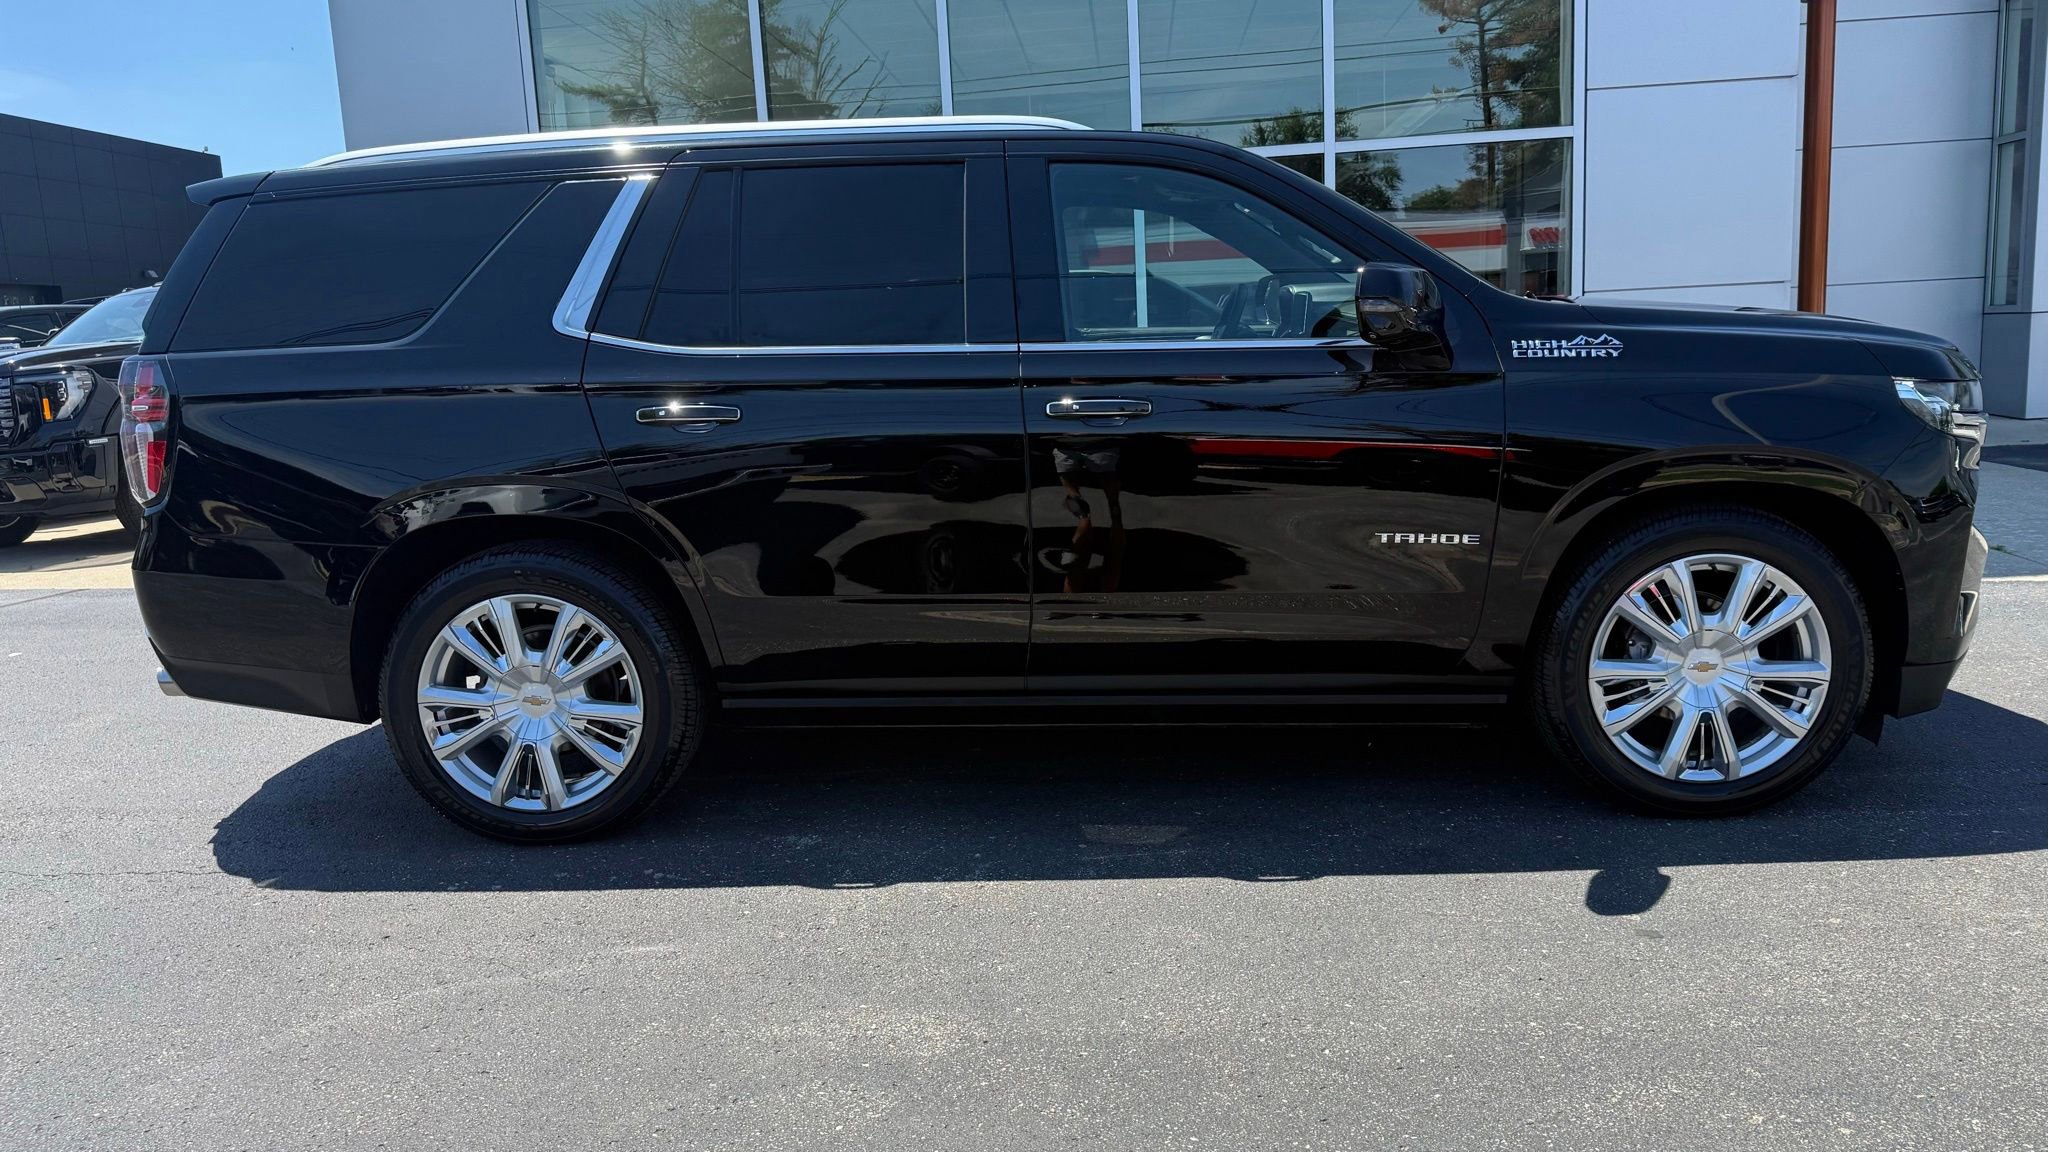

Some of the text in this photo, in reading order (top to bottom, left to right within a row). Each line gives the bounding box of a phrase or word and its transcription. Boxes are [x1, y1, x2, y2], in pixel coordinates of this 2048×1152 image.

[1511, 340, 1568, 349] HIGH
[1512, 348, 1623, 358] COUNTRY
[1375, 532, 1480, 545] TAHOE
